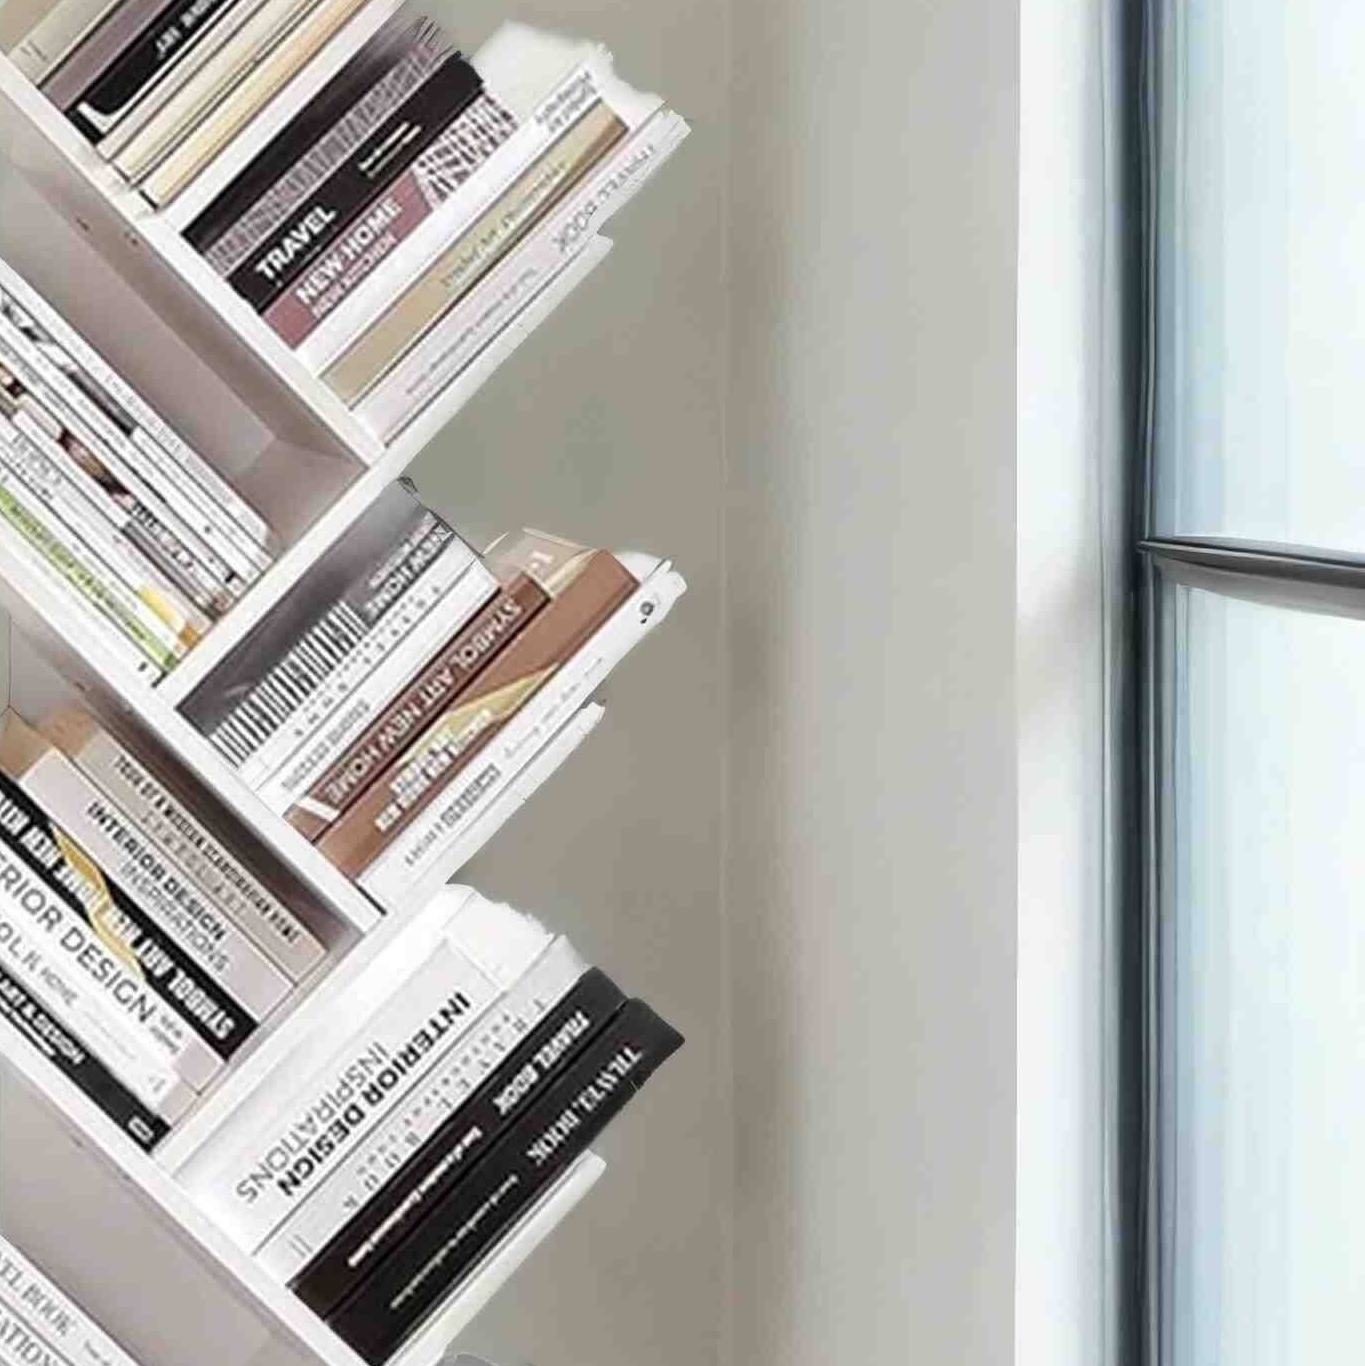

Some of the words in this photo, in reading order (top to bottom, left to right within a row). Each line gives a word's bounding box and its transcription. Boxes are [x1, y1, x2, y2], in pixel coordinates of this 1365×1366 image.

[254, 198, 338, 281] TRAVEL
[293, 250, 348, 305] NEW
[338, 194, 404, 260] HOME
[449, 596, 523, 676] SYMBOL
[374, 700, 424, 753] NEW
[416, 665, 457, 709] ART
[325, 744, 383, 805] HOME
[85, 800, 168, 883] INTERIOR
[160, 875, 228, 942] DESIGN
[57, 924, 159, 1025] DESIGN
[357, 989, 472, 1109] INTERIOR
[531, 1008, 592, 1073] TRAVEL
[231, 1038, 390, 1206] INSPIRATIONS
[489, 1062, 540, 1117] BOOK
[273, 1100, 366, 1199] DESIGN
[523, 1106, 580, 1167] BOOK
